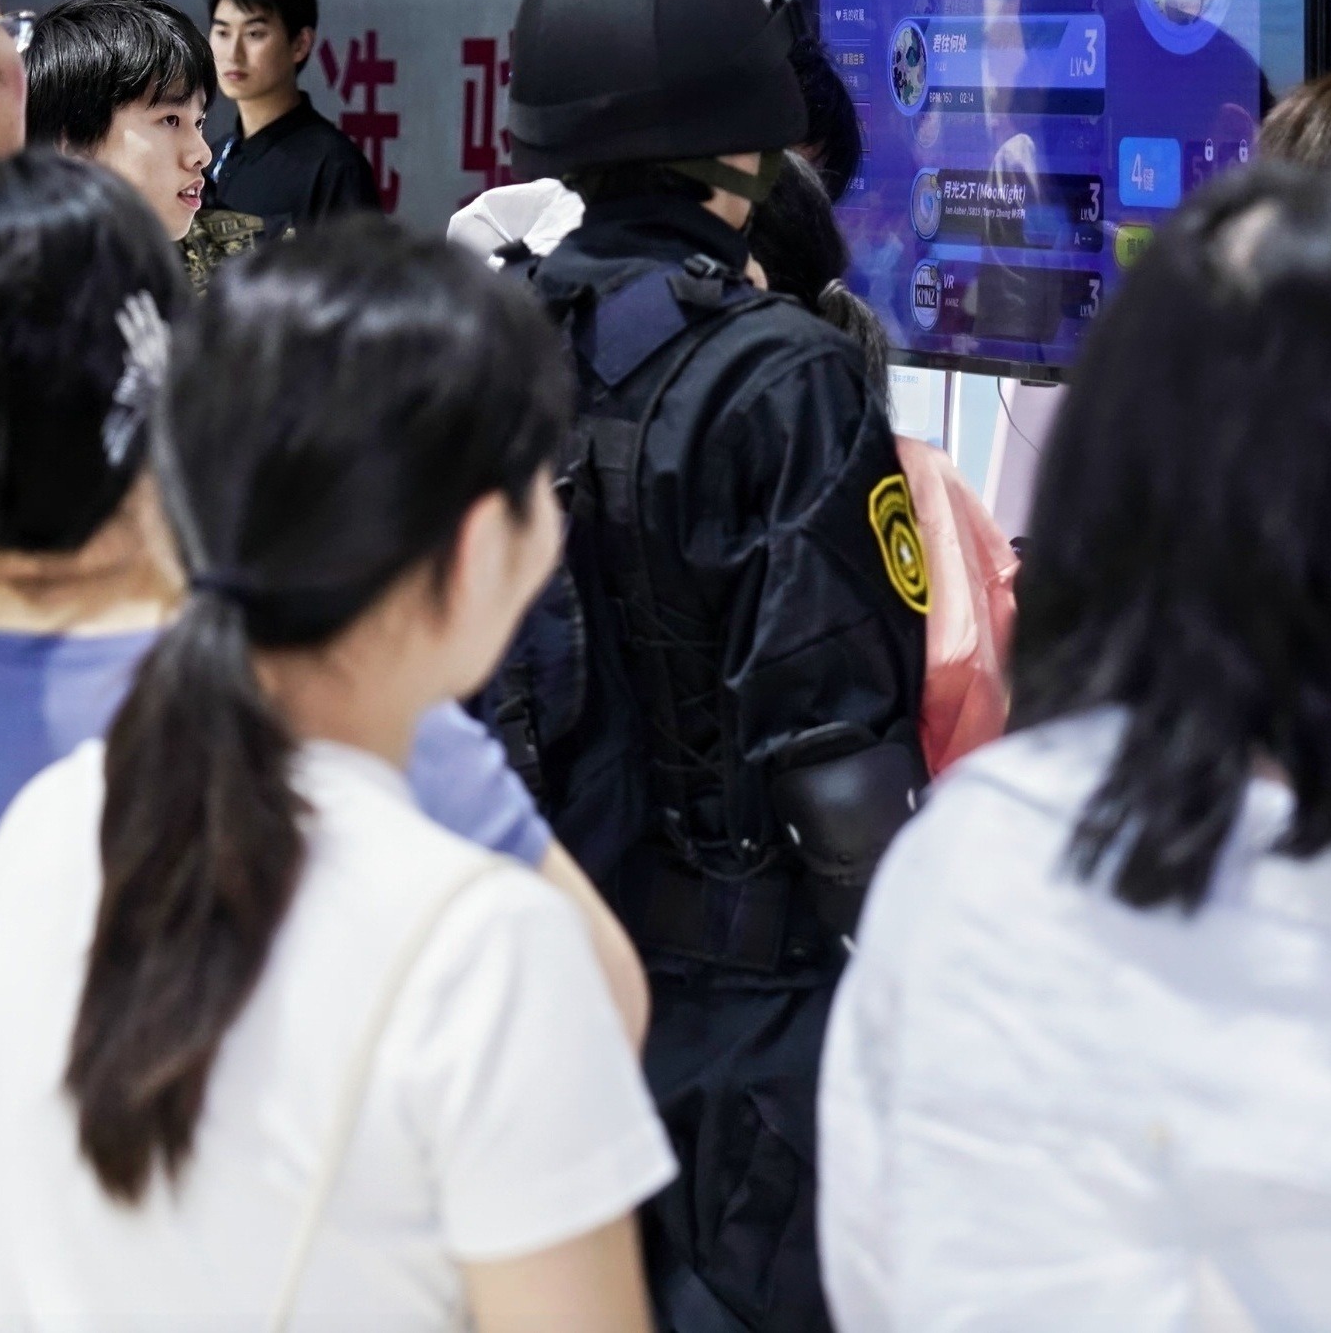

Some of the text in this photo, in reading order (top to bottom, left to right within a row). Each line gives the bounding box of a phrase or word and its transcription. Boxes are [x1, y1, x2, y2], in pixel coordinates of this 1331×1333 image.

[932, 33, 967, 54] 君往何处
[944, 181, 1026, 204] 月光之下 (Moonlight)
[943, 274, 955, 289] VR
